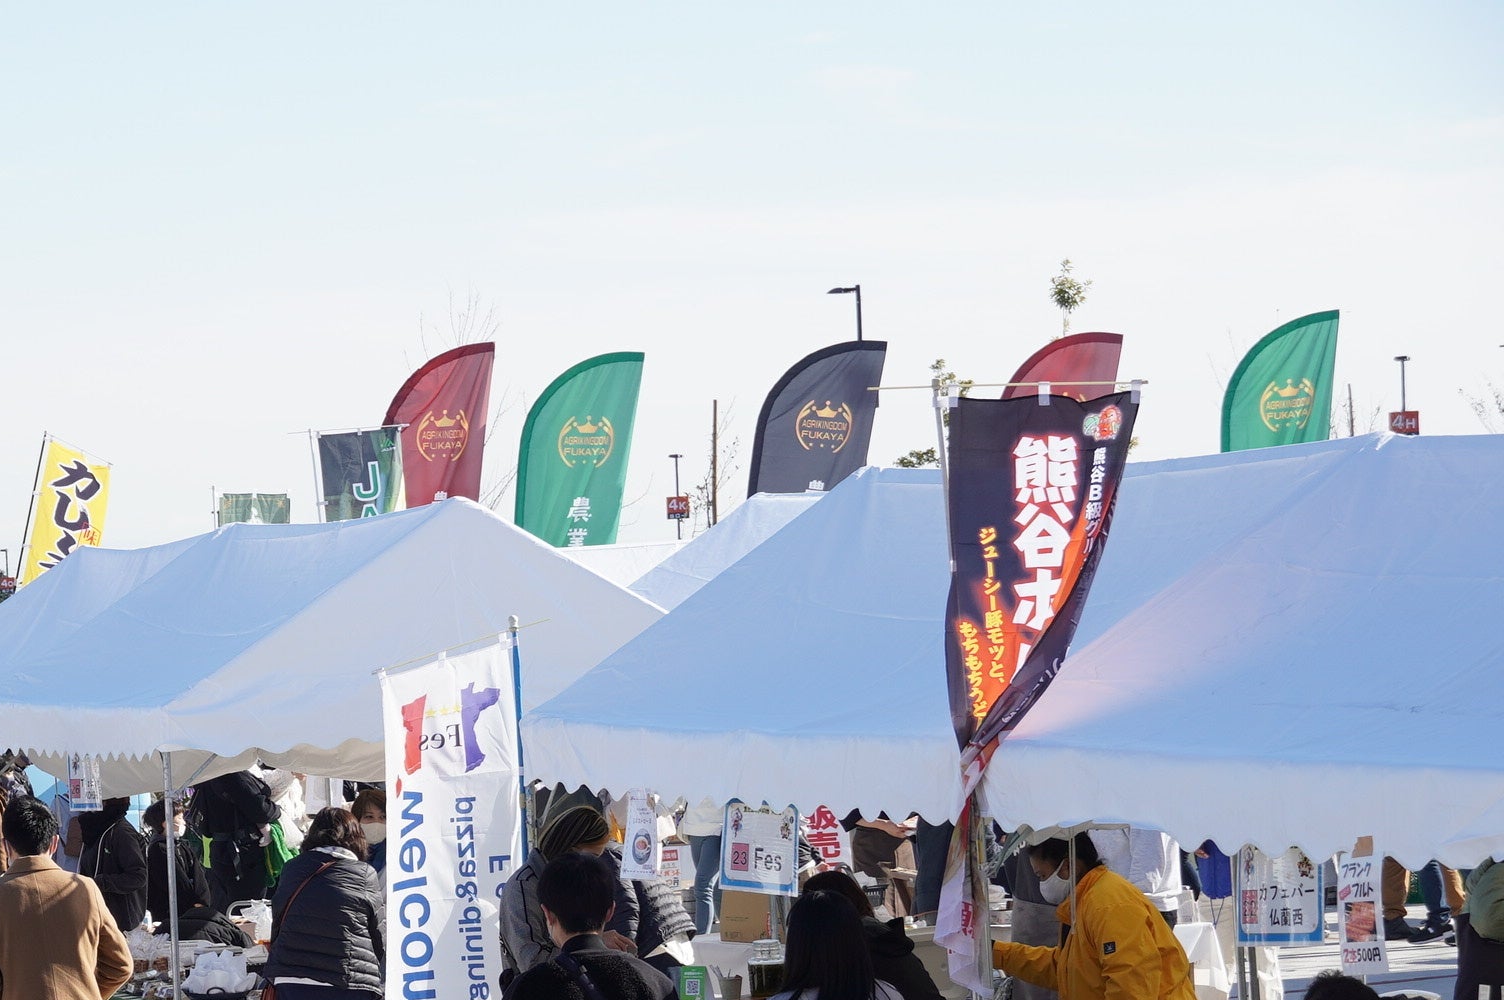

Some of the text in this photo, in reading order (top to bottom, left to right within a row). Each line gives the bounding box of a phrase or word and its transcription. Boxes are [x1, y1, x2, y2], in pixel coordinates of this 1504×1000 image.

[1266, 407, 1310, 420] FUKAYA
[801, 419, 847, 431] AGRIKINGDOM
[1392, 414, 1417, 429] 4H
[422, 429, 463, 439] AGRIKINGDOM
[564, 436, 608, 446] AGRIKINGDOM
[801, 430, 844, 441] FUKAYA
[422, 441, 462, 450] FUKAYA
[563, 447, 607, 456] FUKAYA
[667, 499, 687, 511] 4K
[979, 527, 1005, 684] ジューシー豚モツと、
[732, 847, 783, 872] 23 Fes
[1341, 862, 1372, 879] フランク
[1259, 883, 1315, 901] カフェバー
[1351, 882, 1374, 899] フルト
[1269, 908, 1304, 927] 仏蘭西
[1343, 946, 1382, 964] 2本500円
